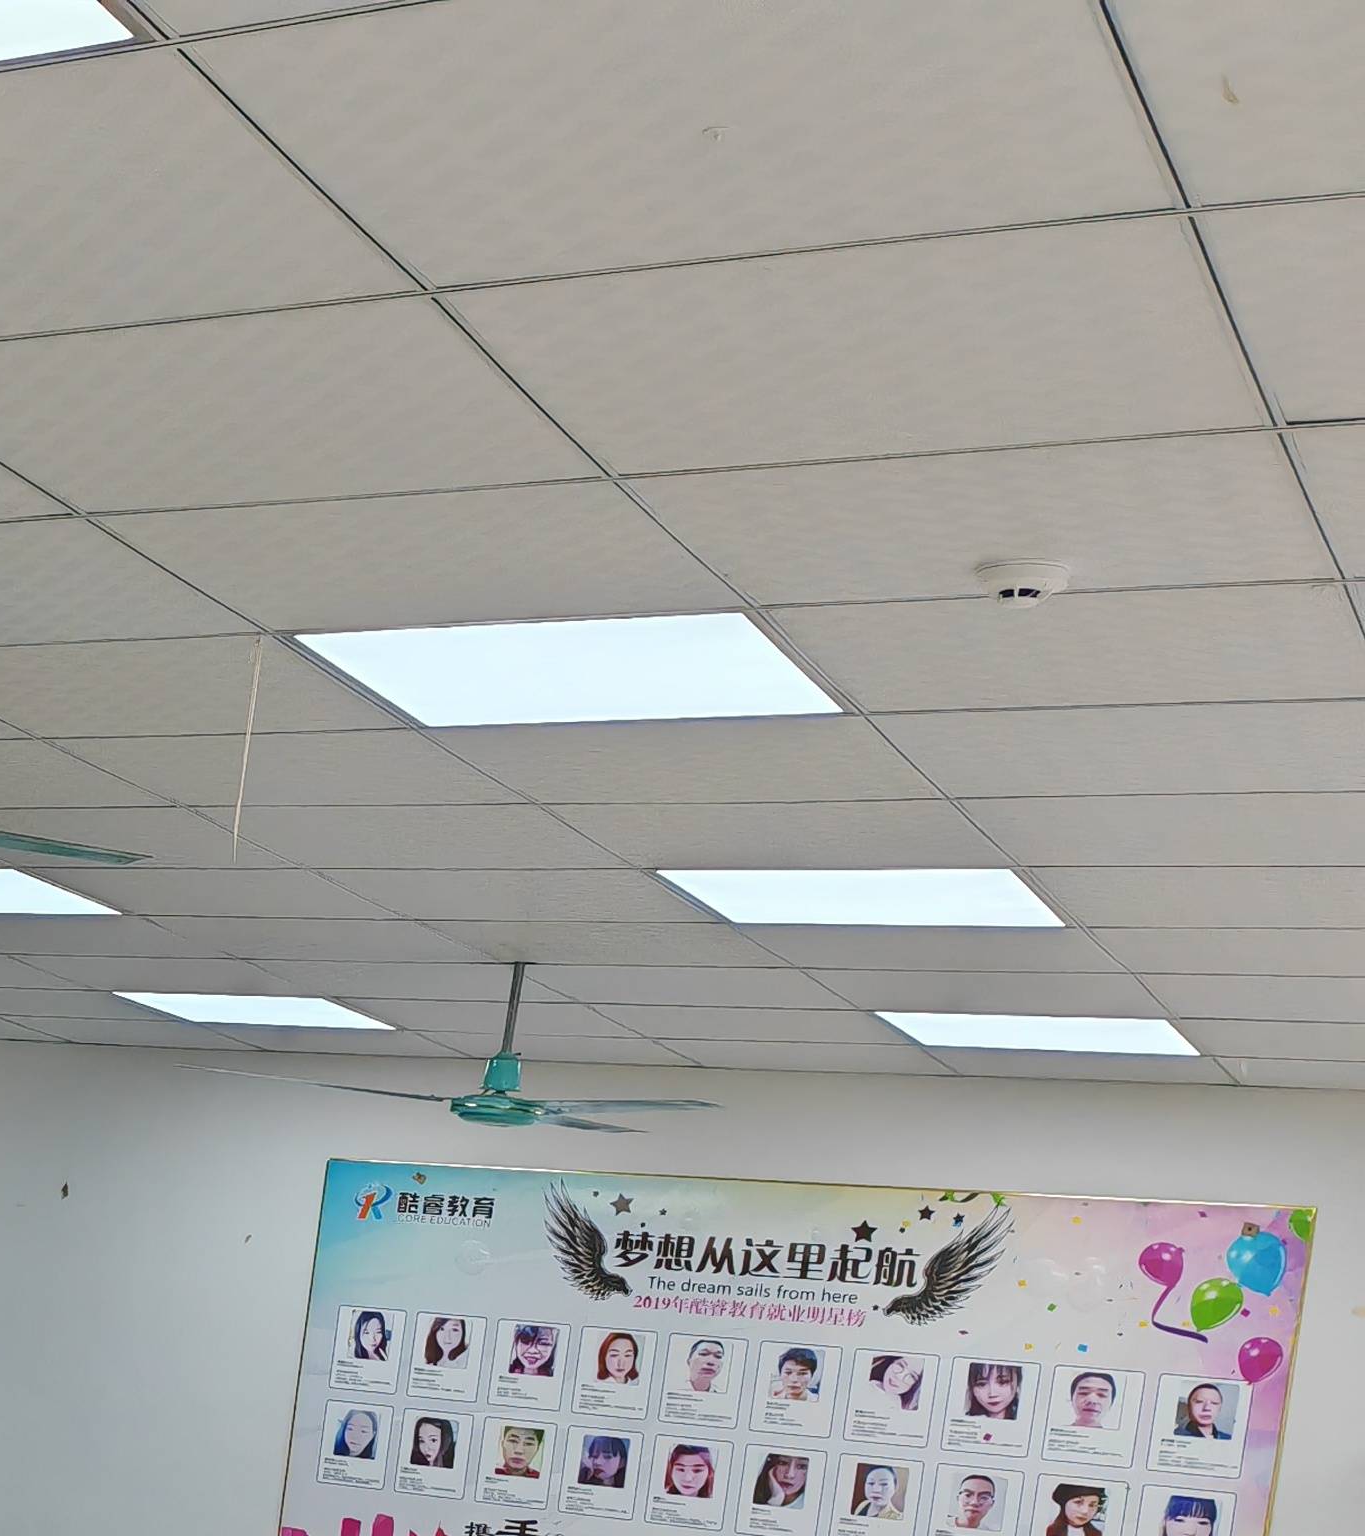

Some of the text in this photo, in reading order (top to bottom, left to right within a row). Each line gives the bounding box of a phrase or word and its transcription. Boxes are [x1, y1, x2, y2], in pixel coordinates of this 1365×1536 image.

[397, 1192, 495, 1219] 酷睿教育
[397, 1214, 491, 1228] CORE EDUCATION
[614, 1230, 925, 1287] 梦想从这里起航
[648, 1276, 859, 1305] The dream sails from here
[633, 1295, 868, 1328] 2019年酷睿教育就业明星榜
